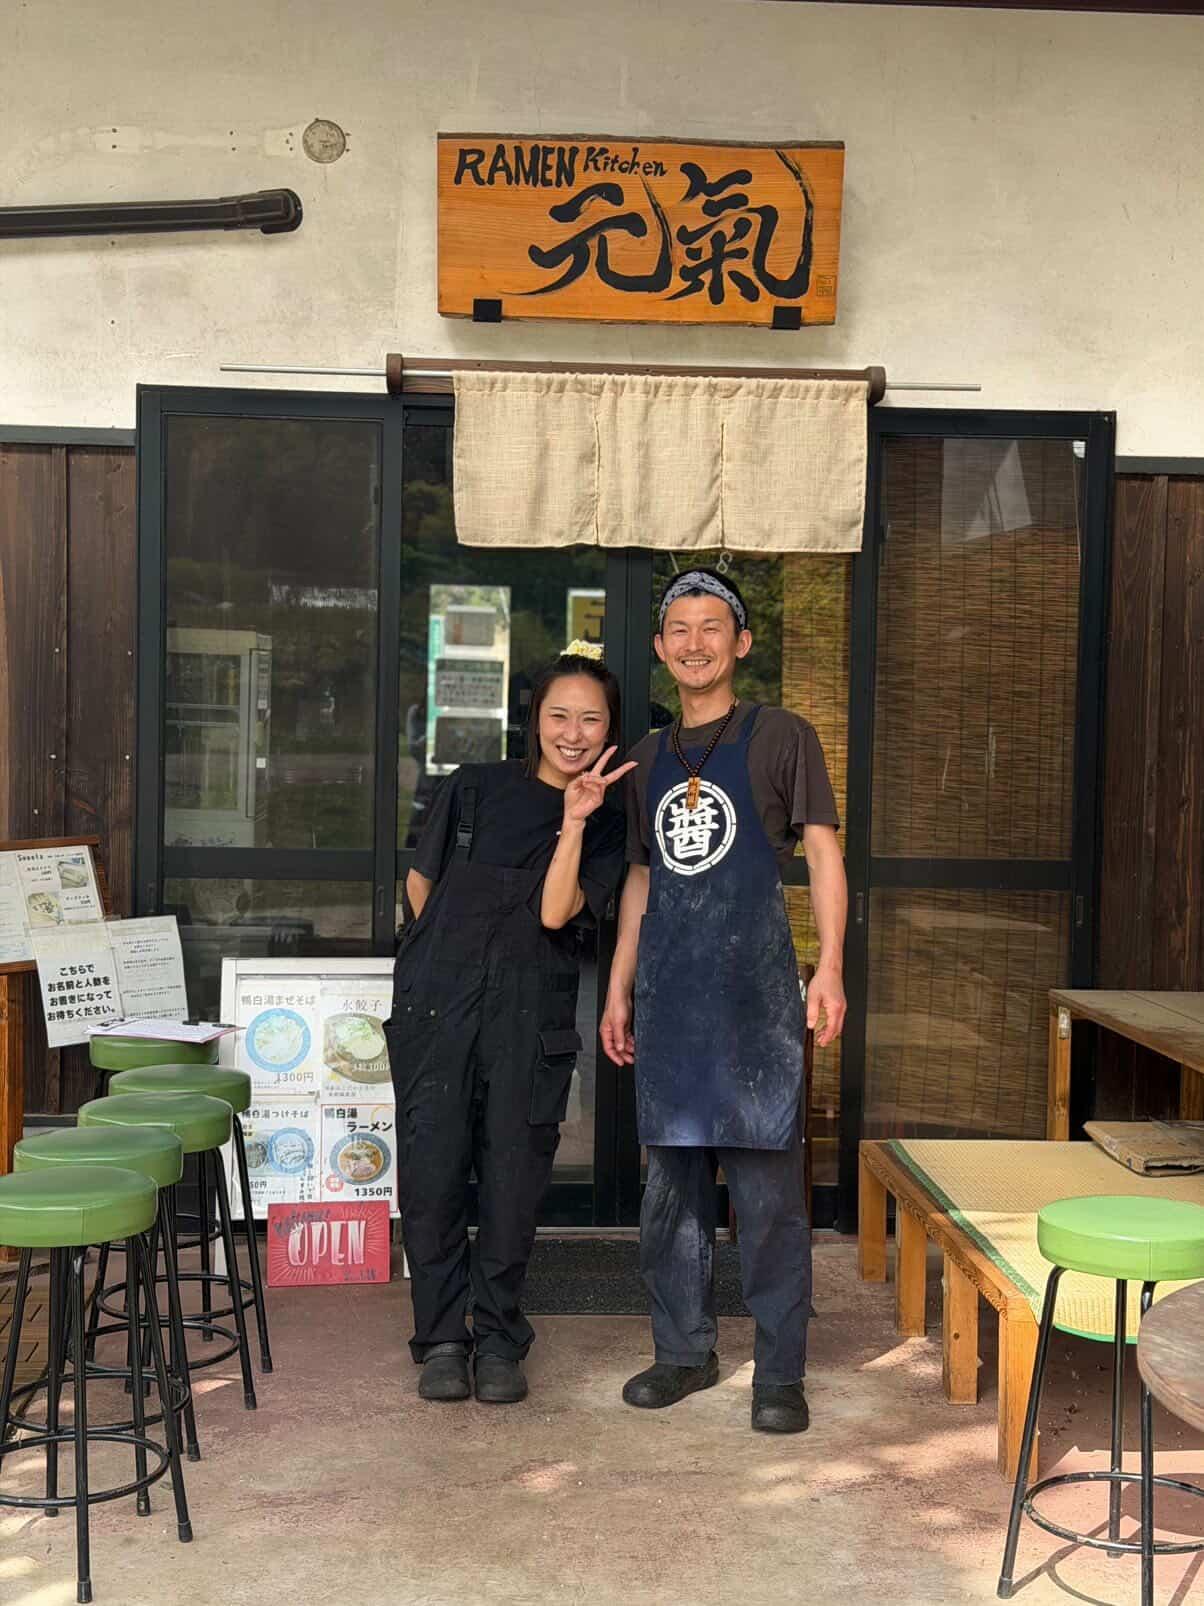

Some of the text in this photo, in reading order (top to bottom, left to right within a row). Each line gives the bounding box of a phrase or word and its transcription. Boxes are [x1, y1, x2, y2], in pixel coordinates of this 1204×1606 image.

[454, 144, 668, 187] RAMEN Kitchen
[59, 964, 95, 976] こちらで
[47, 976, 111, 993] お名前と人数を
[49, 990, 113, 1007] お書きになって
[343, 999, 383, 1012] 水餃子
[47, 1005, 116, 1021] お待ちください。
[346, 1121, 393, 1133] ラーメン
[249, 1180, 268, 1190] 50円
[354, 1187, 393, 1197] 1350円
[288, 1219, 367, 1266] OPEN
